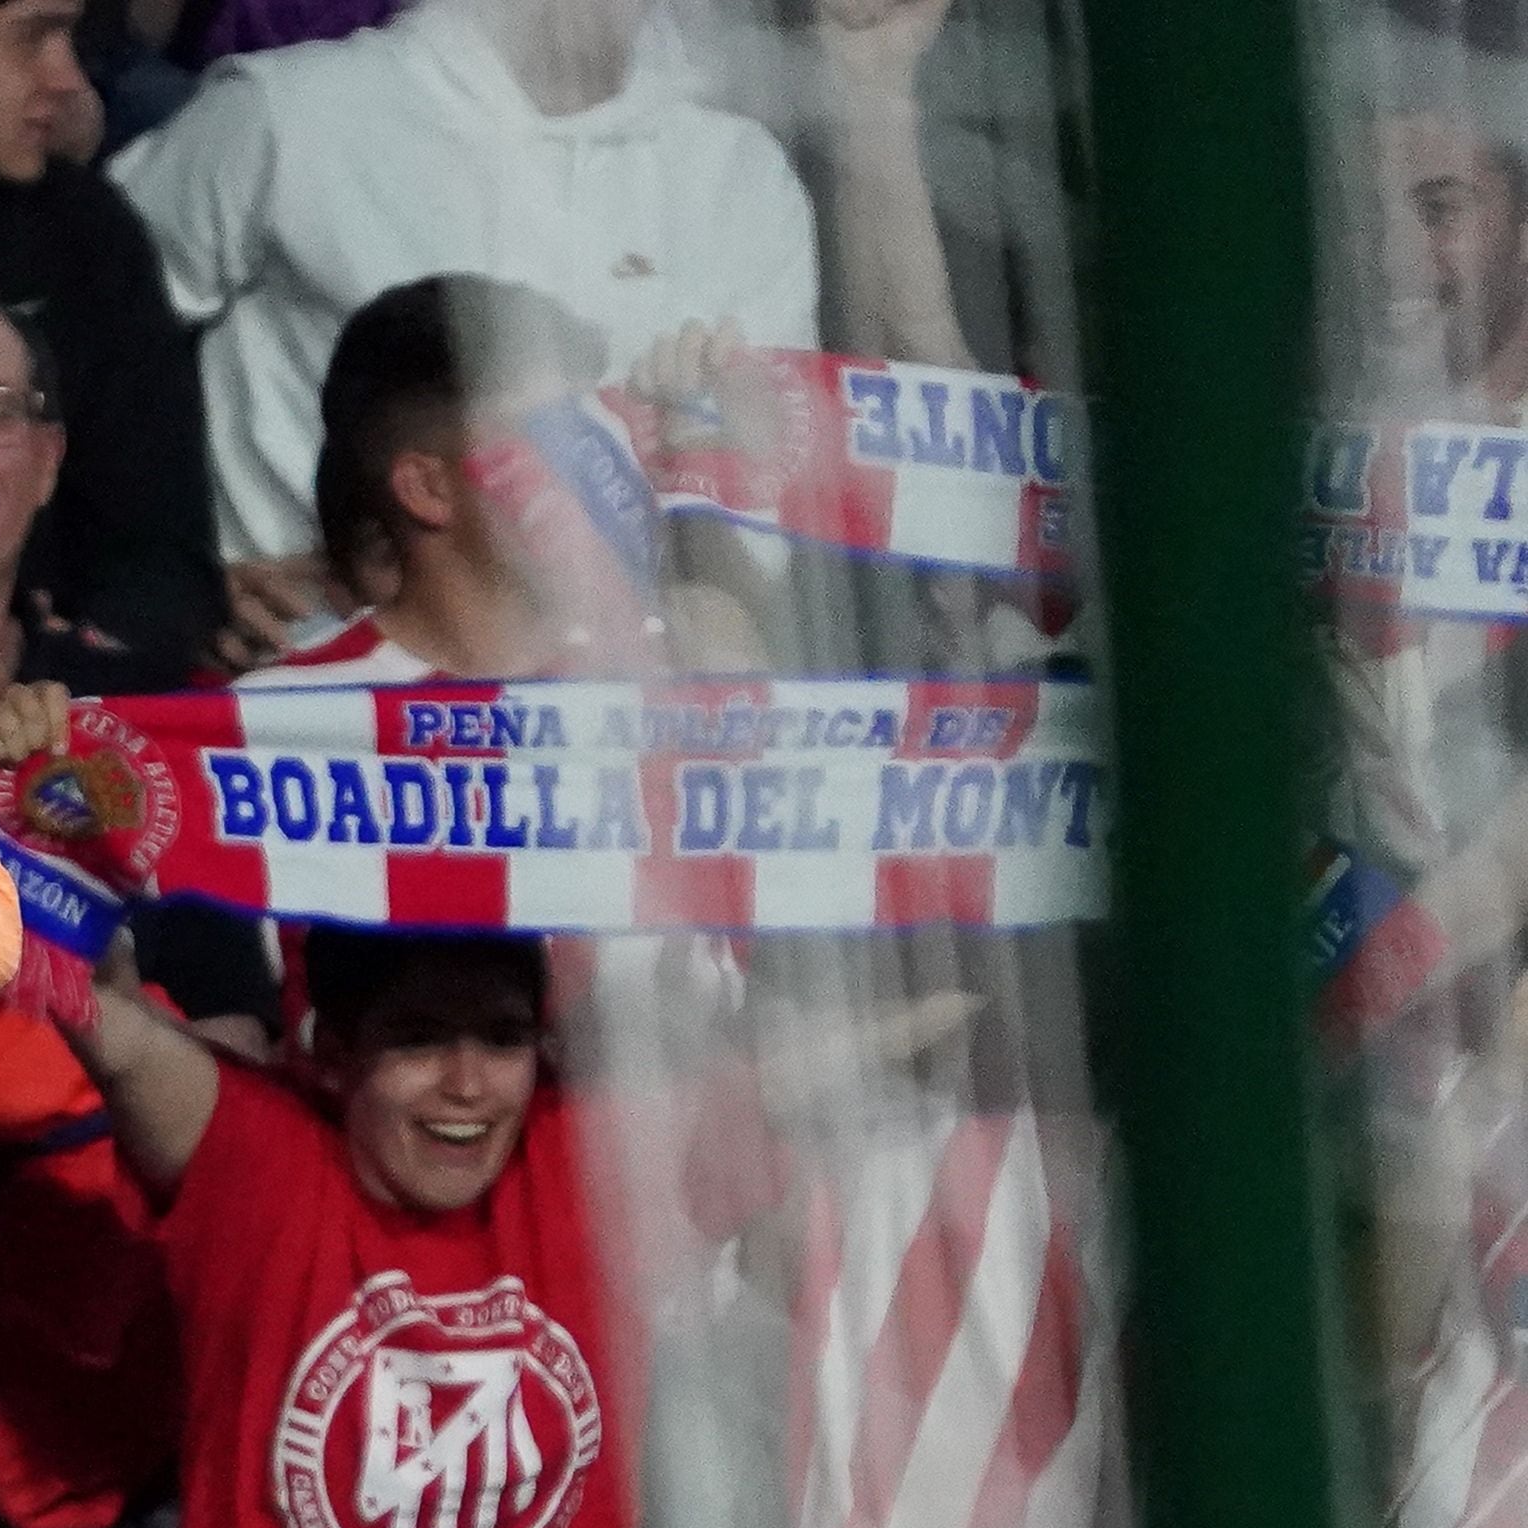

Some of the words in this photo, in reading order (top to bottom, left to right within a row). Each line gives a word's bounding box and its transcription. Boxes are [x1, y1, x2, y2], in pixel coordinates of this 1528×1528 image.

[207, 754, 644, 849] BOADILLA
[679, 764, 842, 850] DEL
[871, 762, 1105, 850] MONT
